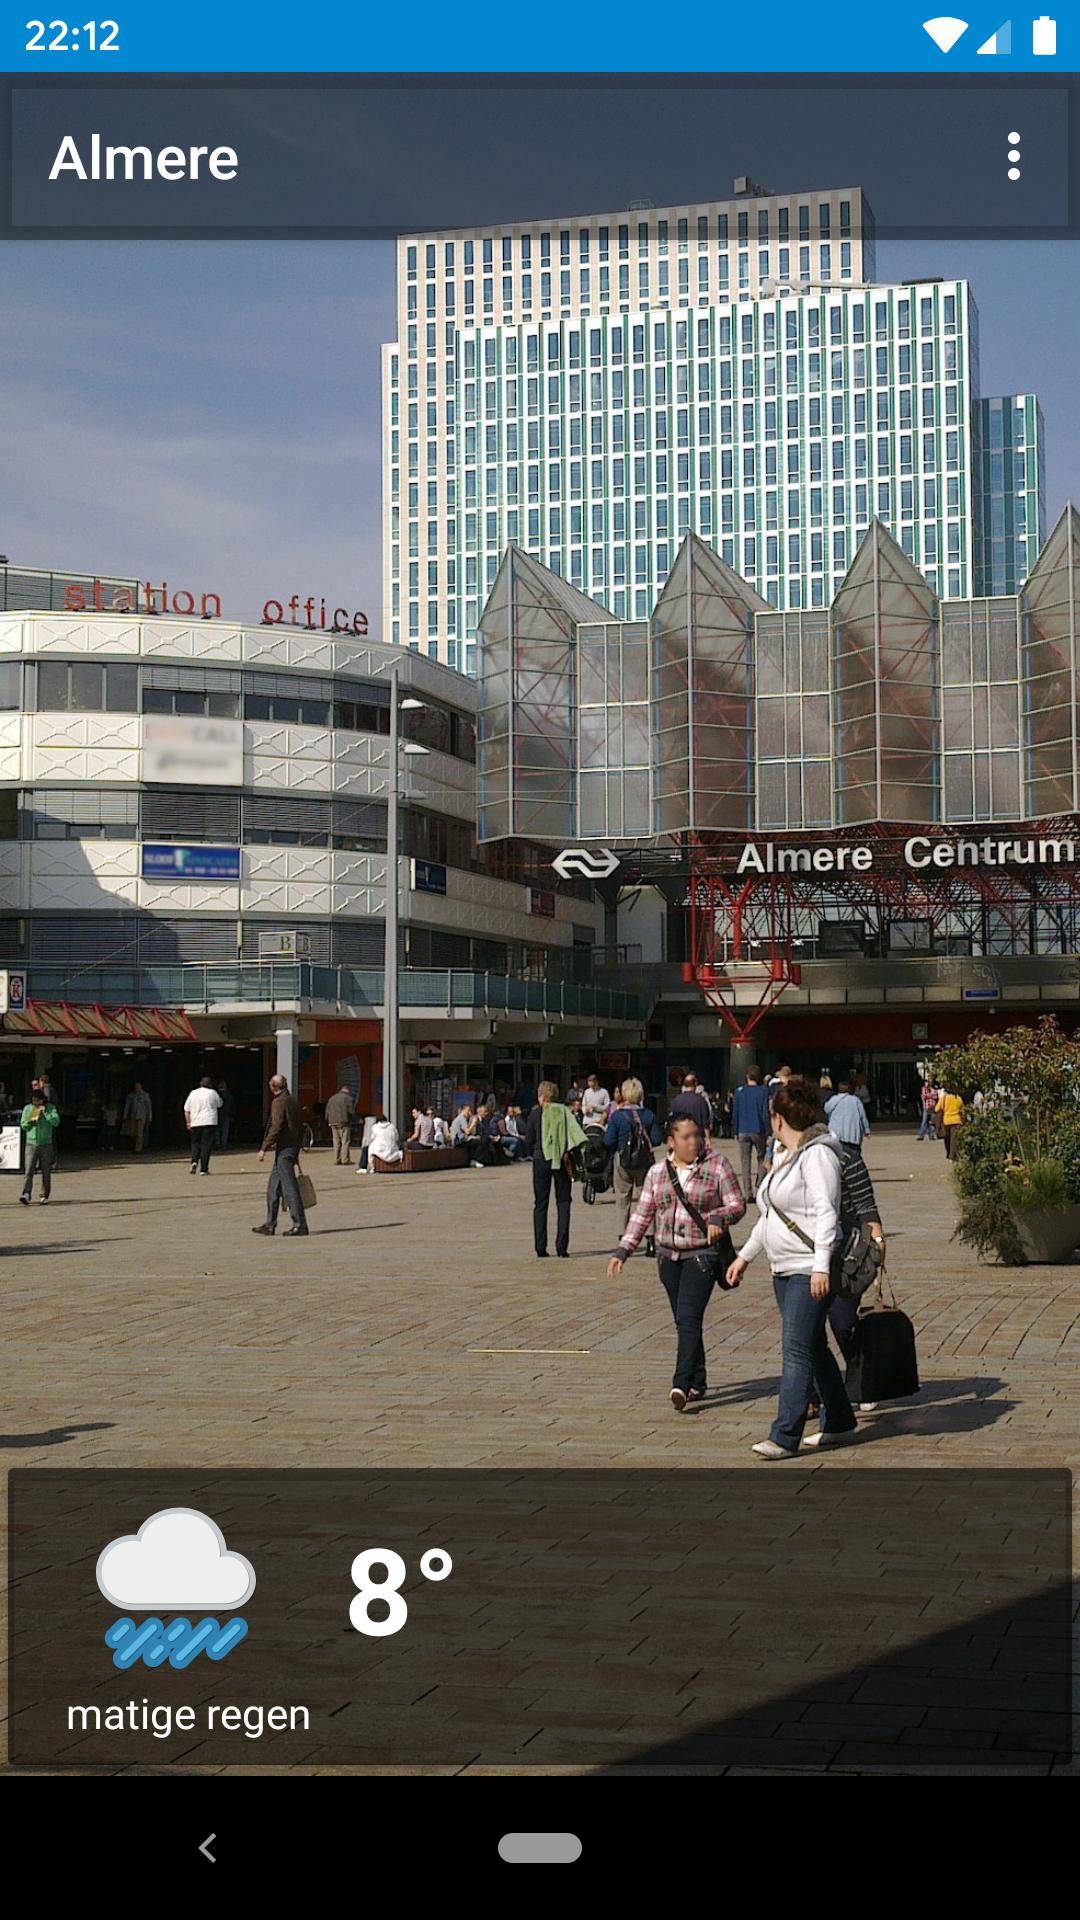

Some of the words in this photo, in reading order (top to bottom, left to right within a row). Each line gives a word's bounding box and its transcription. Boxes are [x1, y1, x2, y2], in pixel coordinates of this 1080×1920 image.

[64, 580, 221, 617] station
[263, 595, 369, 635] office
[736, 842, 873, 874] Almere
[904, 836, 1076, 867] Centrum
[281, 936, 291, 951] B
